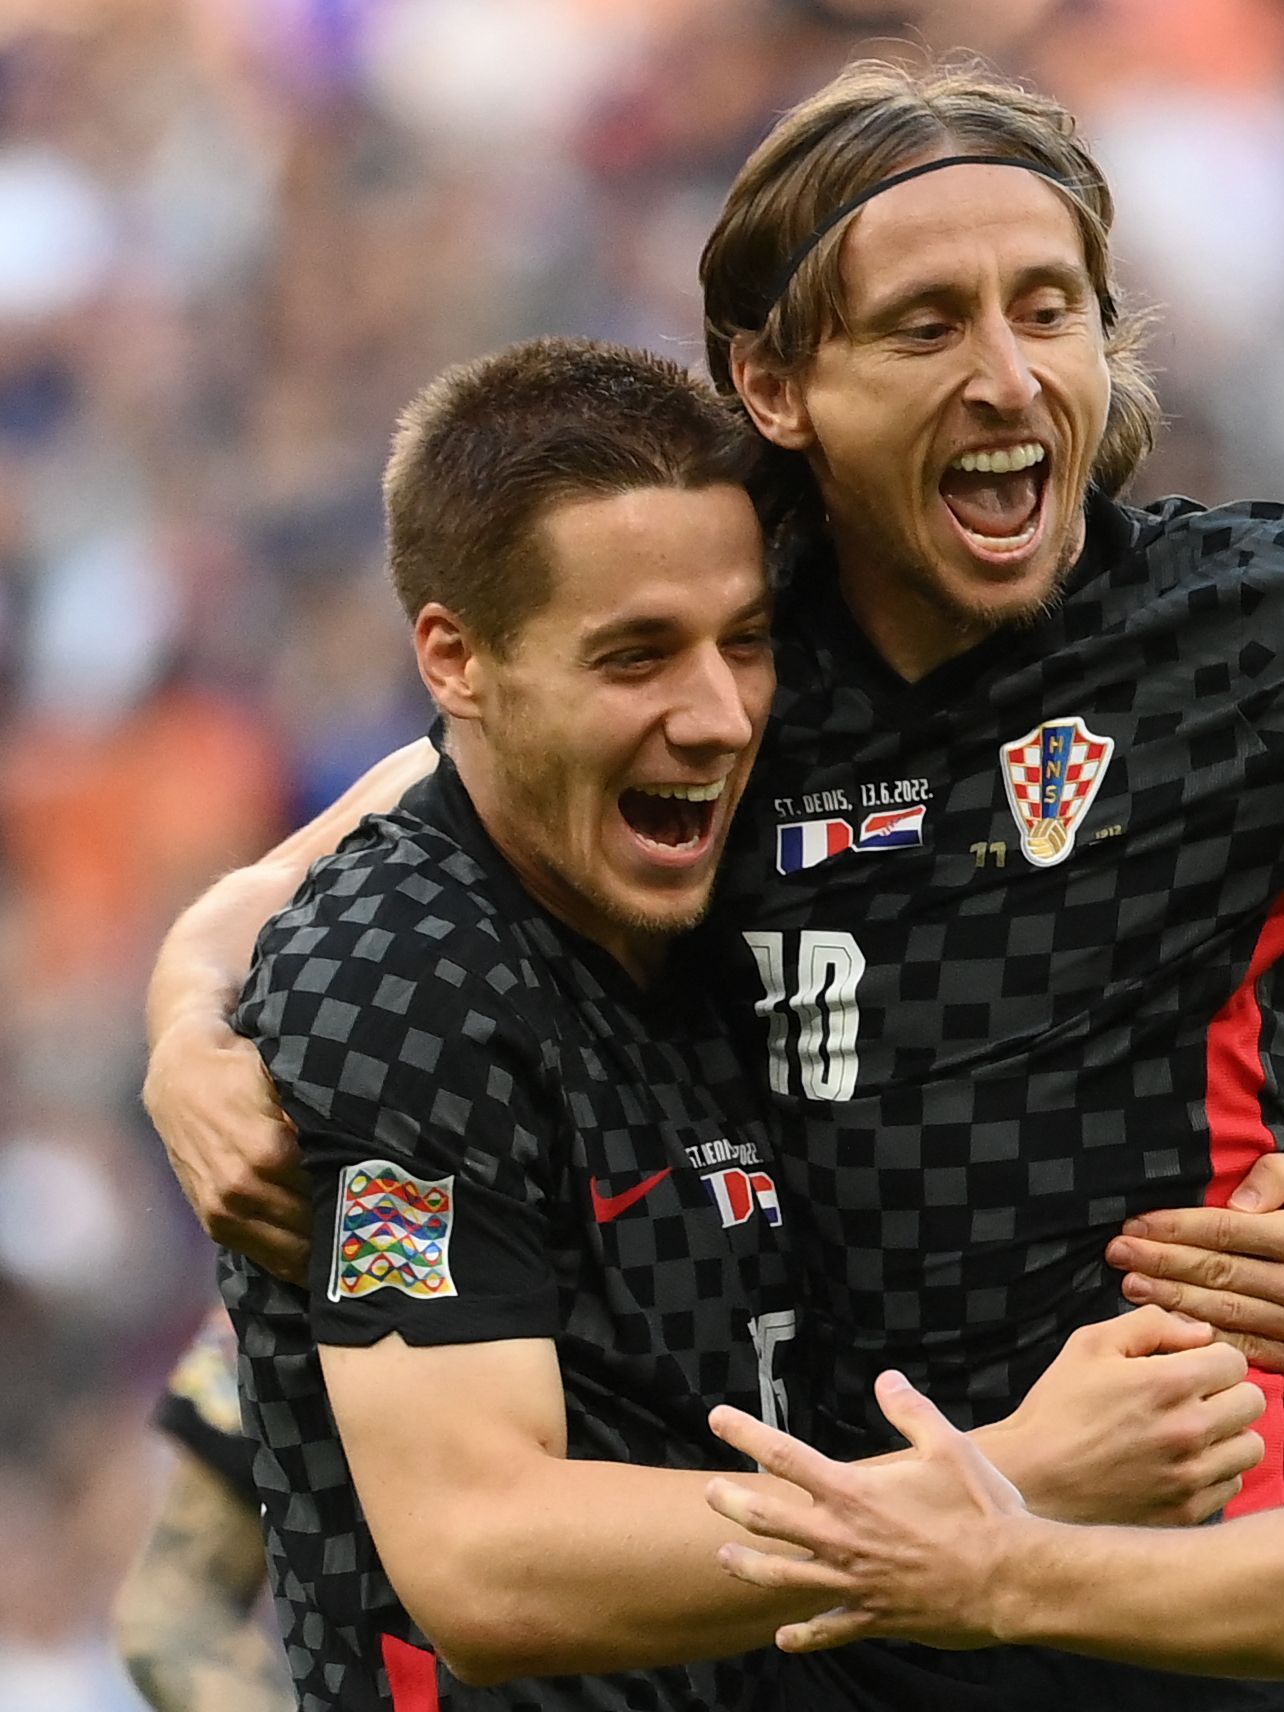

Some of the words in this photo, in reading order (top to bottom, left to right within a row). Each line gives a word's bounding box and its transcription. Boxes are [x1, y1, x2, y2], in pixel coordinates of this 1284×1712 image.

[774, 799, 801, 818] ST.
[802, 789, 853, 814] DENIS,
[860, 778, 934, 807] 13.6.2022.
[1045, 736, 1065, 804] HNS
[742, 931, 866, 1101] 10
